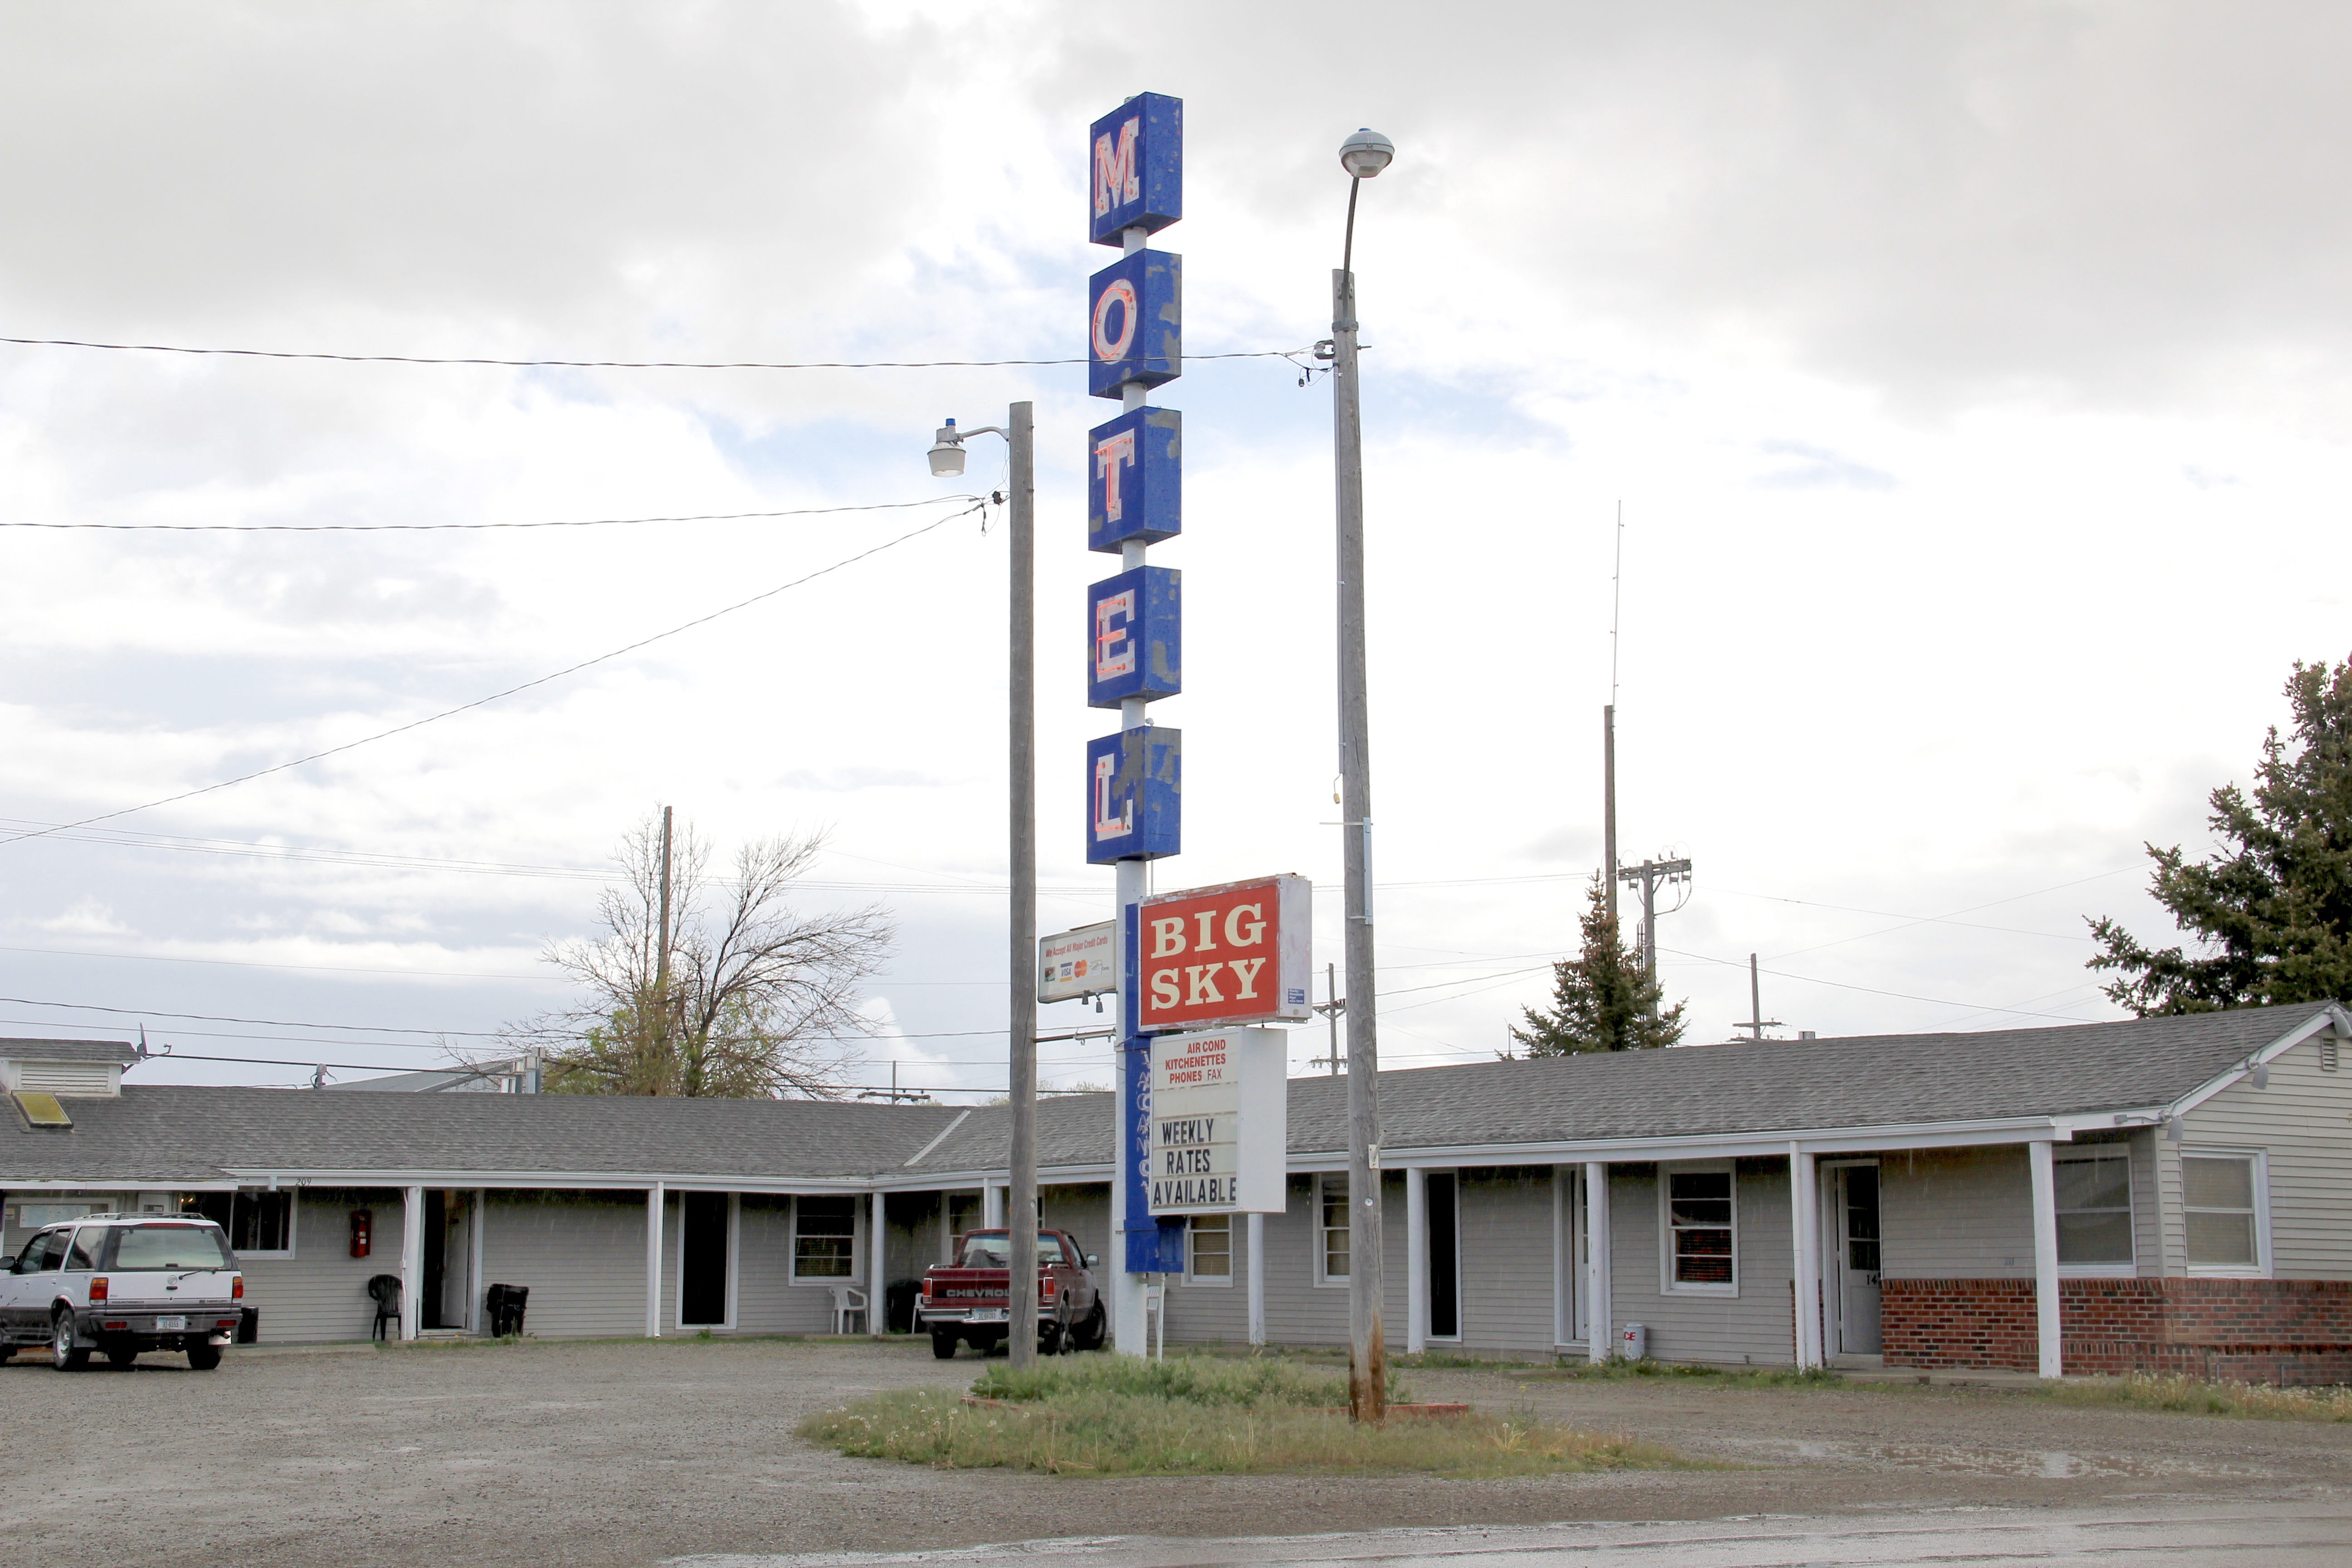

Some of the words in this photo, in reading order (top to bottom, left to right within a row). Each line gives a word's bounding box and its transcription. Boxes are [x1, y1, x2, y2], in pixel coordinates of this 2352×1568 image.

[1093, 115, 1140, 842] MOTEL
[1151, 902, 1267, 959] BIG
[1046, 948, 1052, 957] We
[1053, 945, 1066, 956] Accept
[1072, 941, 1083, 952] Major
[1084, 938, 1096, 949] Credit
[1096, 936, 1108, 946] Cards
[1061, 967, 1071, 977] VISA
[1151, 957, 1266, 1010] SKY
[1187, 1042, 1200, 1054] AIR
[1202, 1039, 1226, 1053] COND
[1165, 1053, 1226, 1070] KITCHENETTES
[1170, 1070, 1202, 1084] PHONES
[1207, 1068, 1222, 1080] FAX
[1162, 1118, 1214, 1145] WEEKLY
[1167, 1148, 1210, 1175] RATES
[295, 1176, 312, 1186] 209
[1153, 1177, 1237, 1205] AVAILABLE
[1867, 1274, 1877, 1285] 14
[946, 1289, 1009, 1297] CHEVROL
[1623, 1331, 1636, 1341] CE
